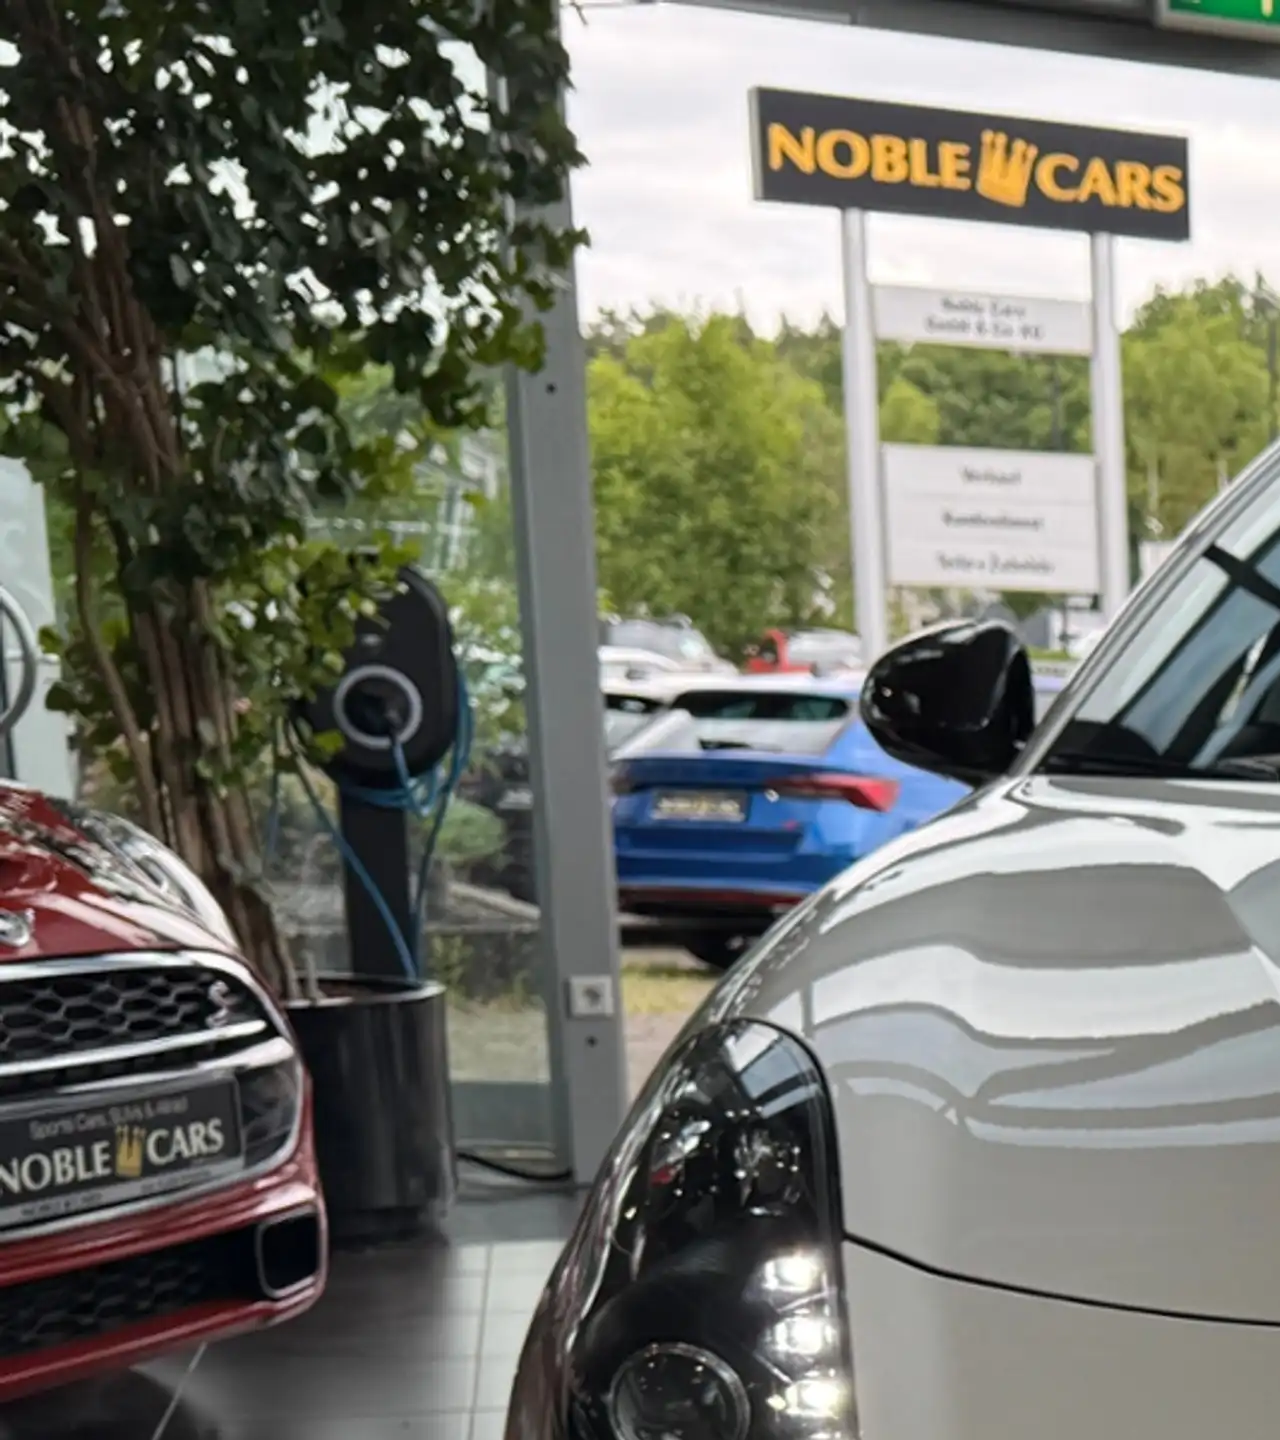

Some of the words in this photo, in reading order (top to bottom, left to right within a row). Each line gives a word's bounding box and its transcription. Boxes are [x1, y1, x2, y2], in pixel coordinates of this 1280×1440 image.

[767, 122, 972, 191] NOBLE
[1034, 153, 1185, 213] CARS
[147, 1118, 224, 1166] CARS
